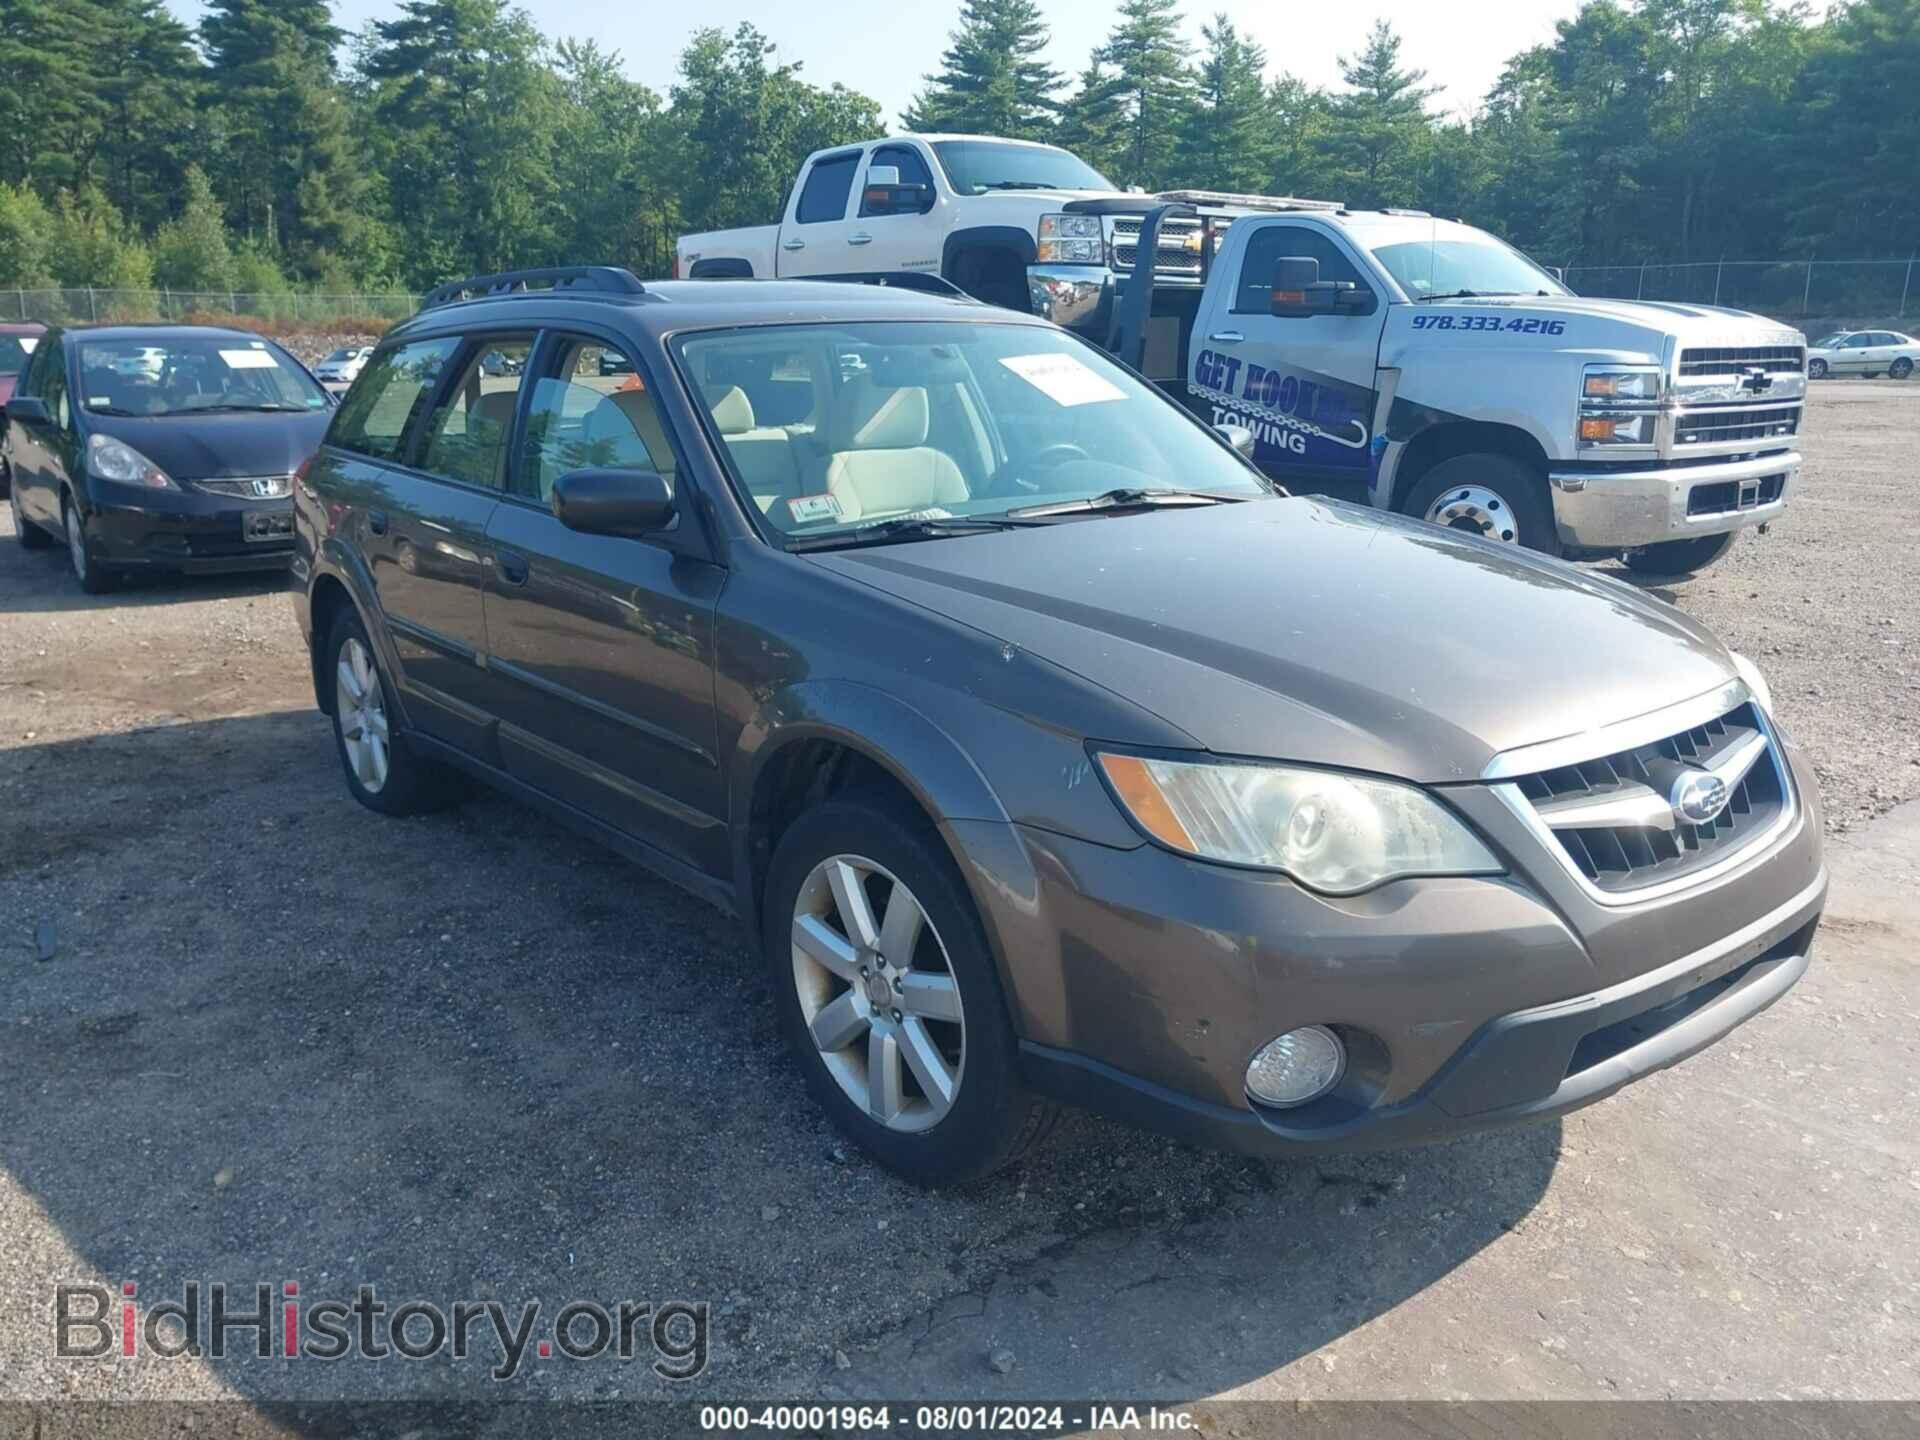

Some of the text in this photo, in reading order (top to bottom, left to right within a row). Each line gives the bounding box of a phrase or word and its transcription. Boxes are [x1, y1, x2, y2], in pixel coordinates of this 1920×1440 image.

[1411, 315, 1567, 336] 978.333.4216
[1195, 349, 1242, 395] GET
[1211, 406, 1306, 454] TOWING
